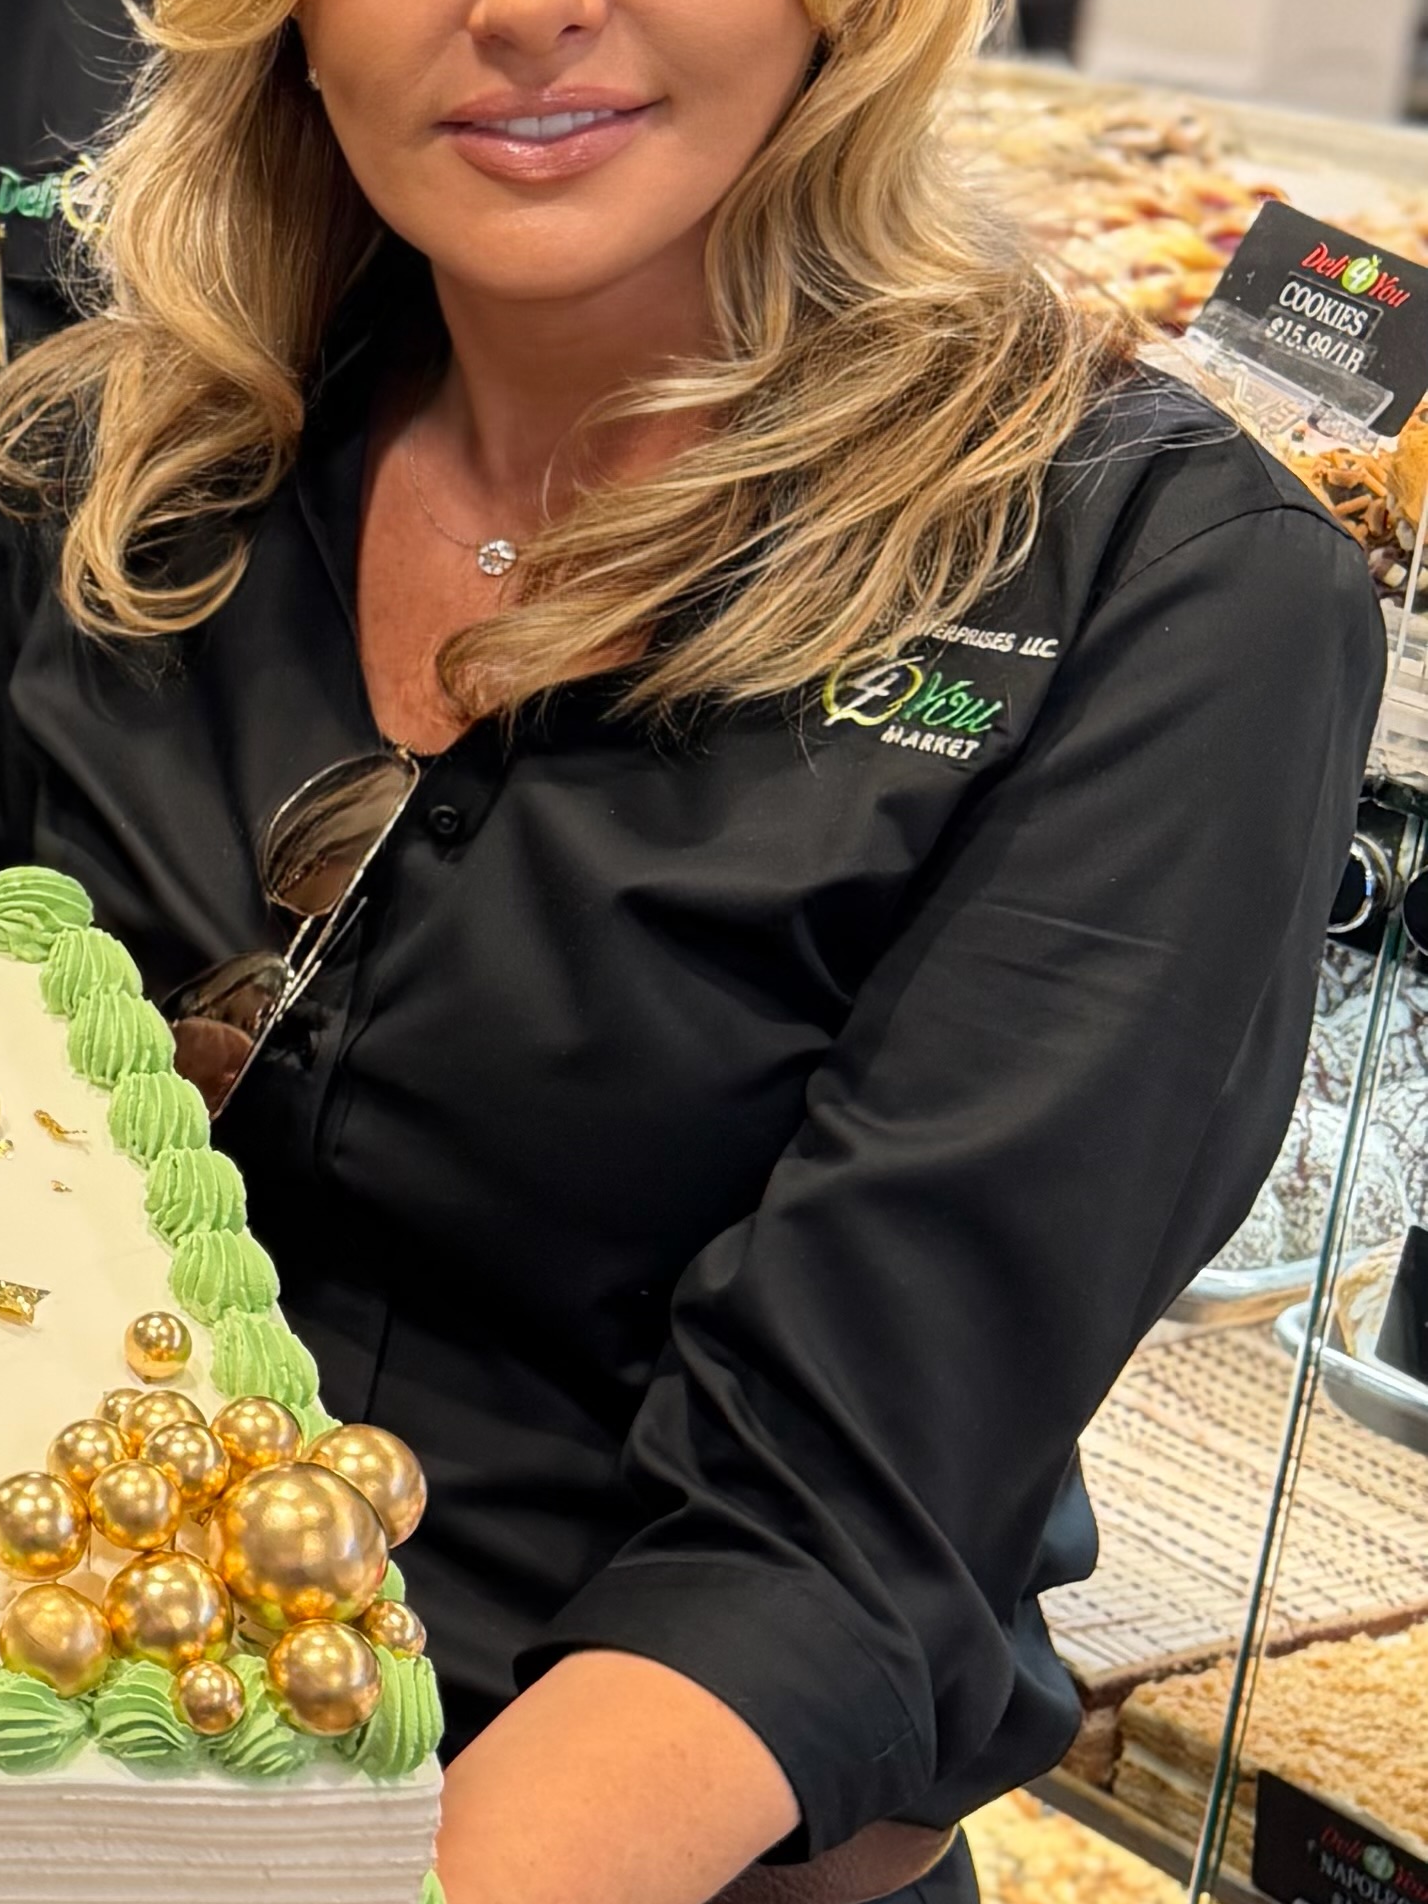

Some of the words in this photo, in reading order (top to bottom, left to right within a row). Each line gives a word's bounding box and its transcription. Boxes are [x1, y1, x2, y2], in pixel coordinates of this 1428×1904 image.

[1301, 242, 1351, 280] Deli
[1368, 272, 1411, 308] You
[1279, 281, 1368, 337] COOKIES
[1019, 636, 1059, 659] LLC
[902, 671, 1003, 733] You
[880, 724, 980, 760] MARKET
